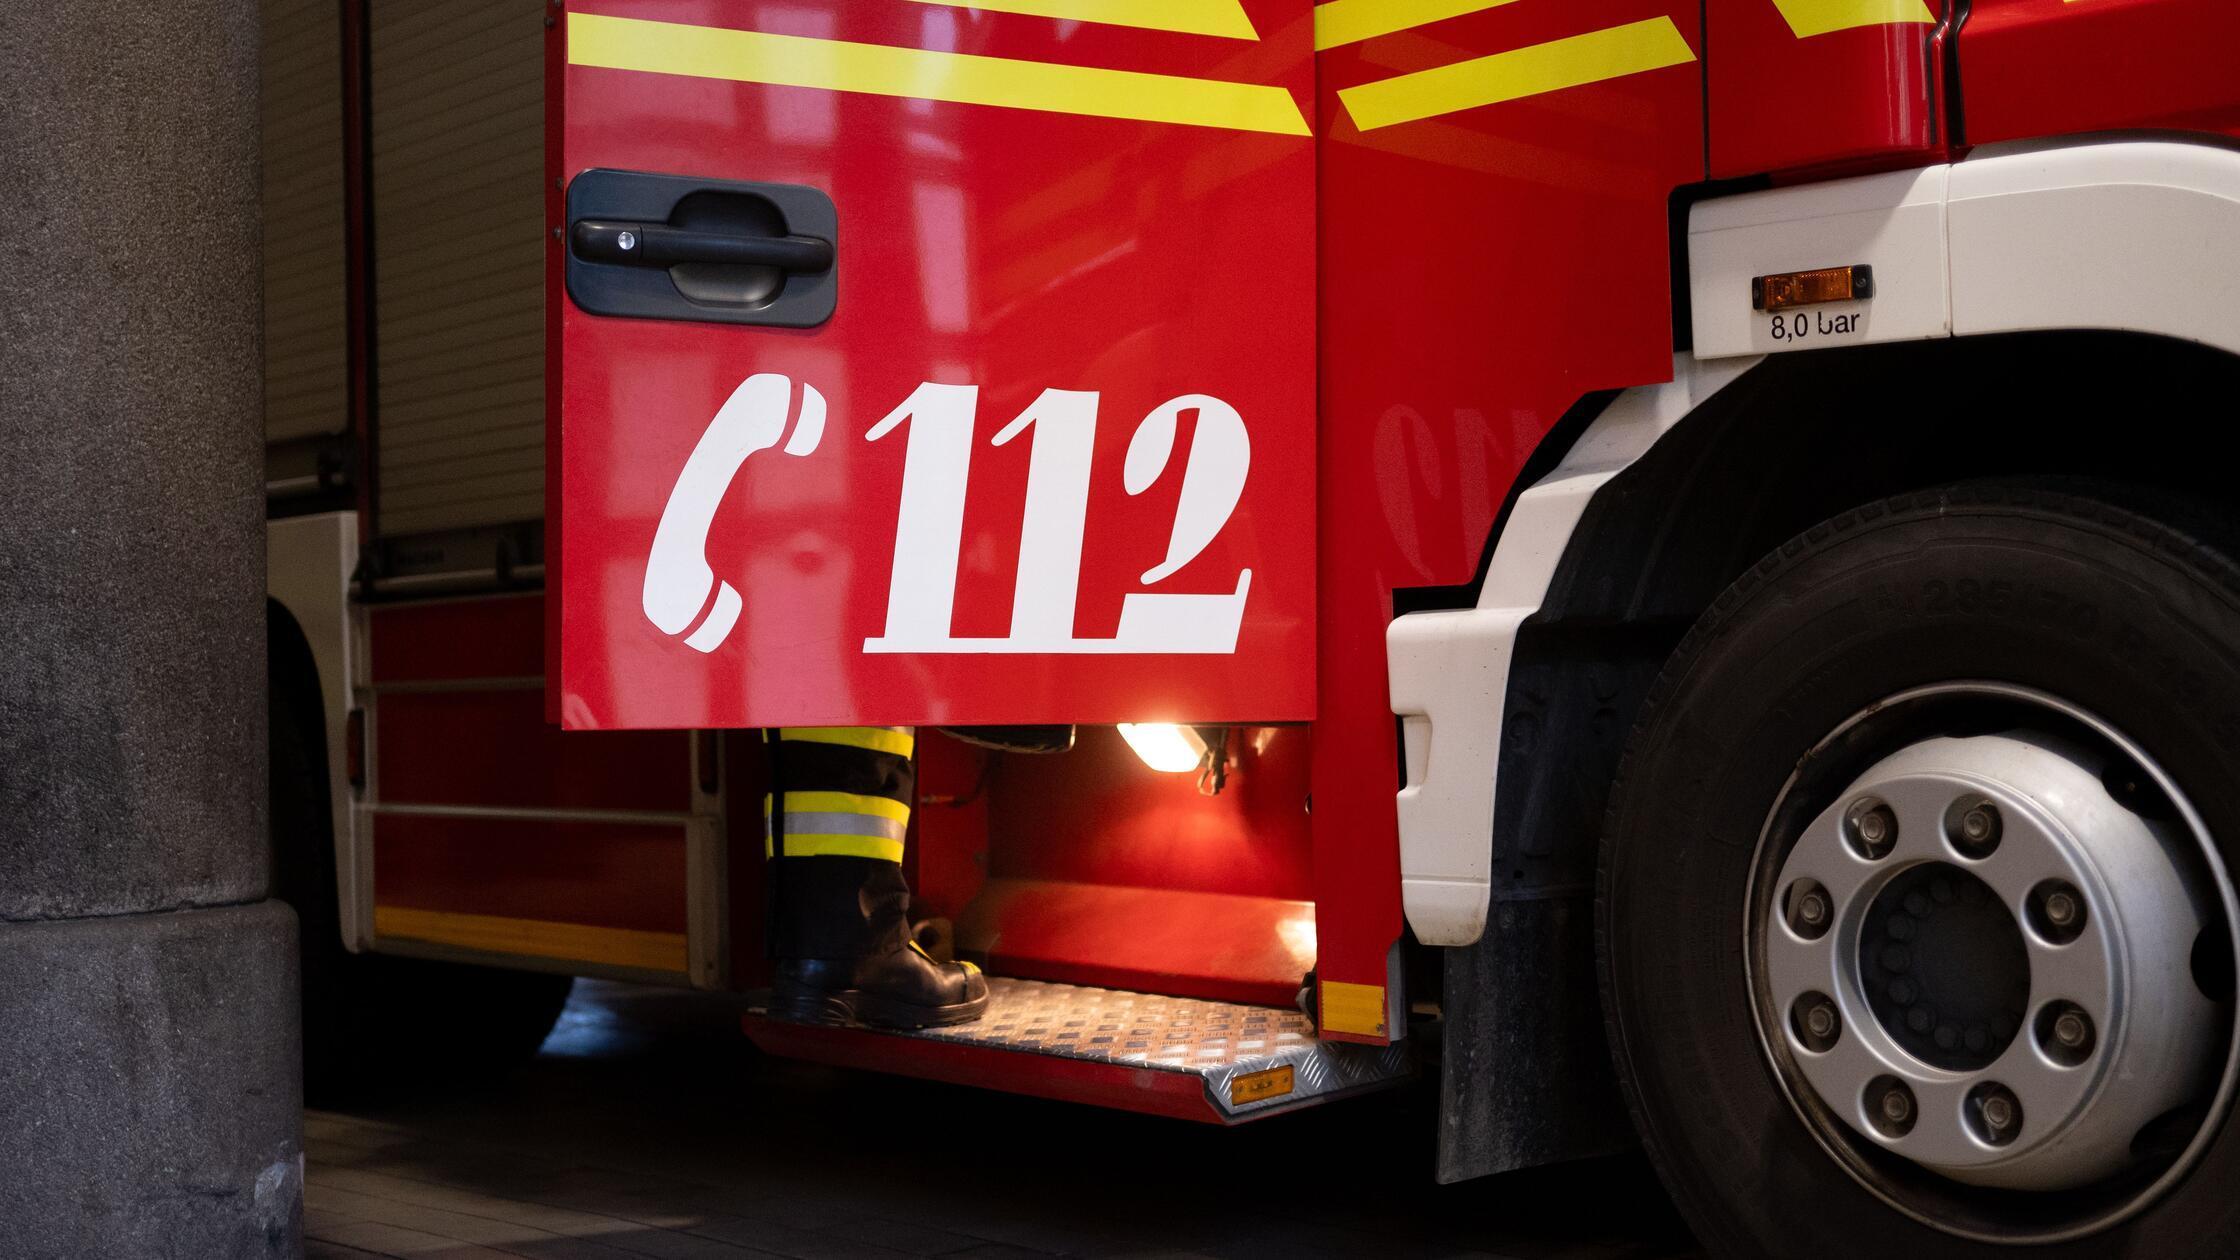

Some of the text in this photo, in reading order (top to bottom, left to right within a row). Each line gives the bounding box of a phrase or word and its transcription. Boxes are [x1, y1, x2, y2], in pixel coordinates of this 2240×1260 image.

[1771, 311, 1860, 342] 8,0 bar
[862, 381, 1252, 654] 112
